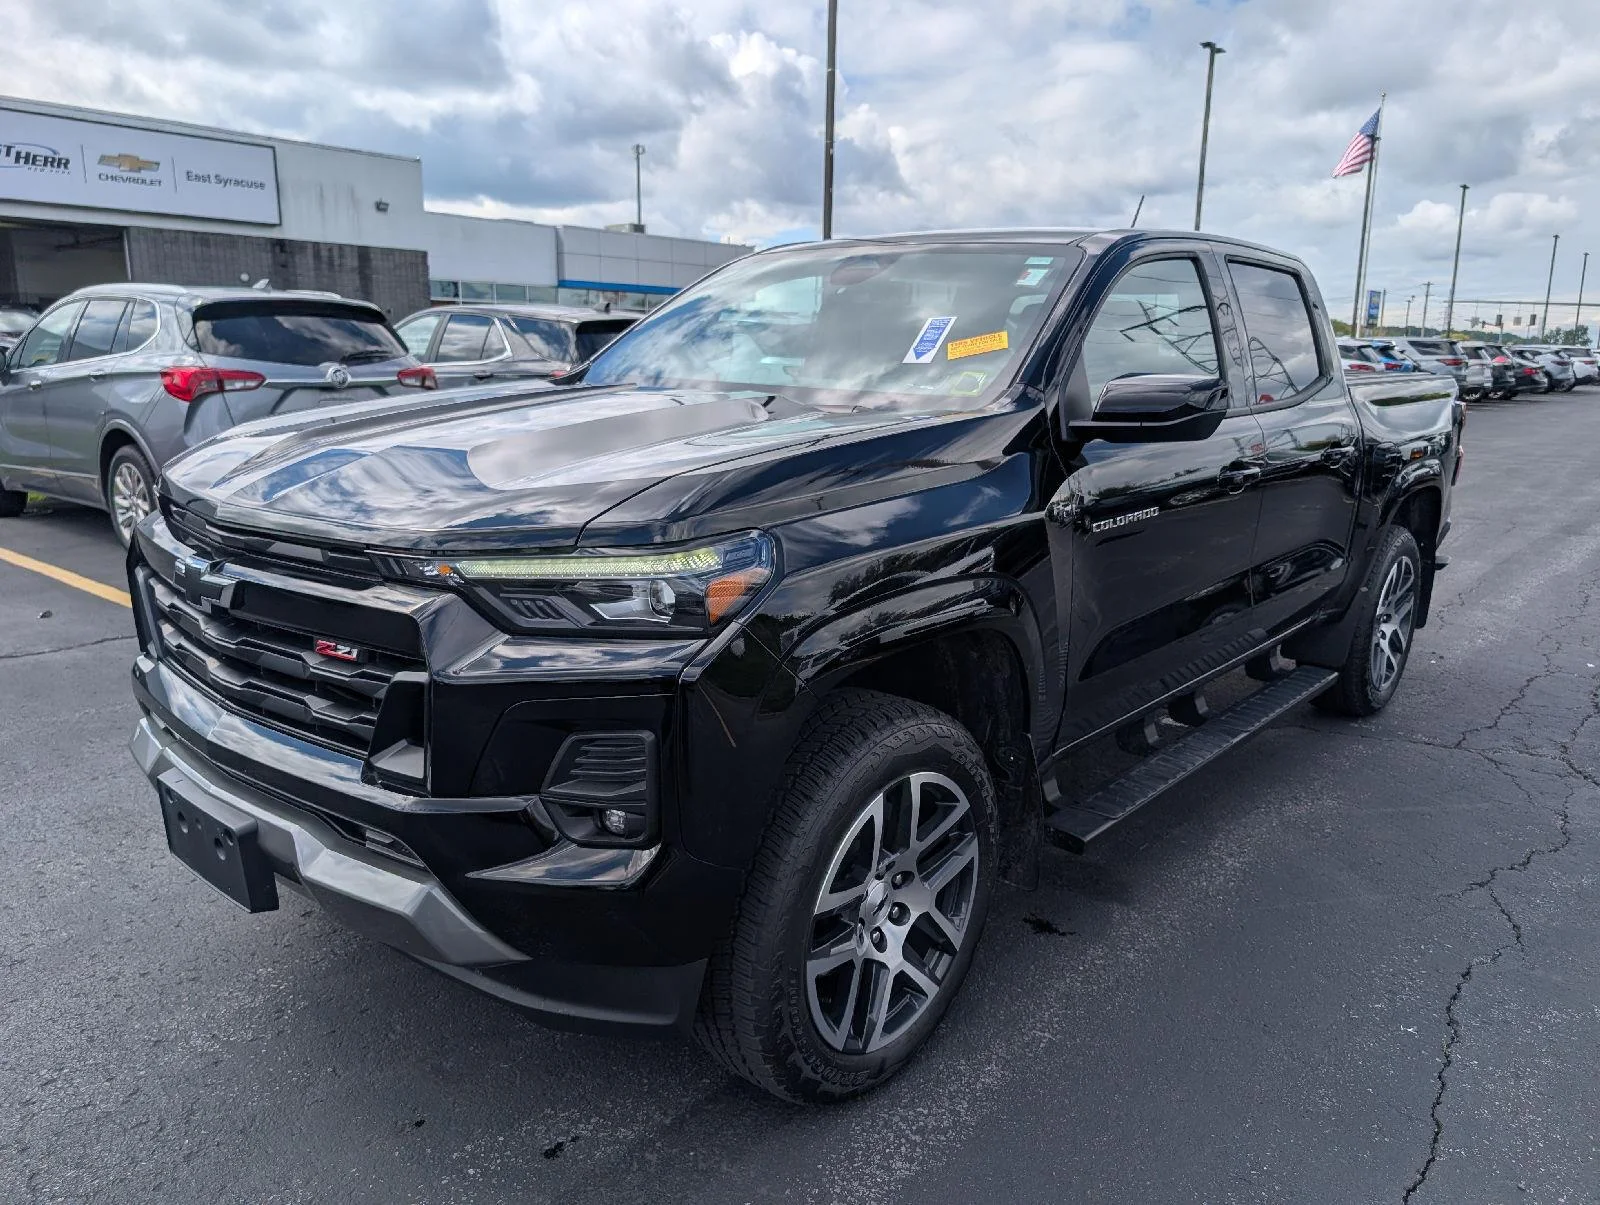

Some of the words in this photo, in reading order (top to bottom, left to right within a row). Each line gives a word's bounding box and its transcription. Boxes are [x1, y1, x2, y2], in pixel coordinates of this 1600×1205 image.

[0, 144, 16, 157] T
[14, 150, 71, 170] HERR
[98, 172, 163, 187] CHEVROLET
[185, 169, 211, 184] East
[214, 172, 266, 191] Syracuse
[1092, 506, 1160, 533] COLORADO
[315, 639, 358, 661] Z71
